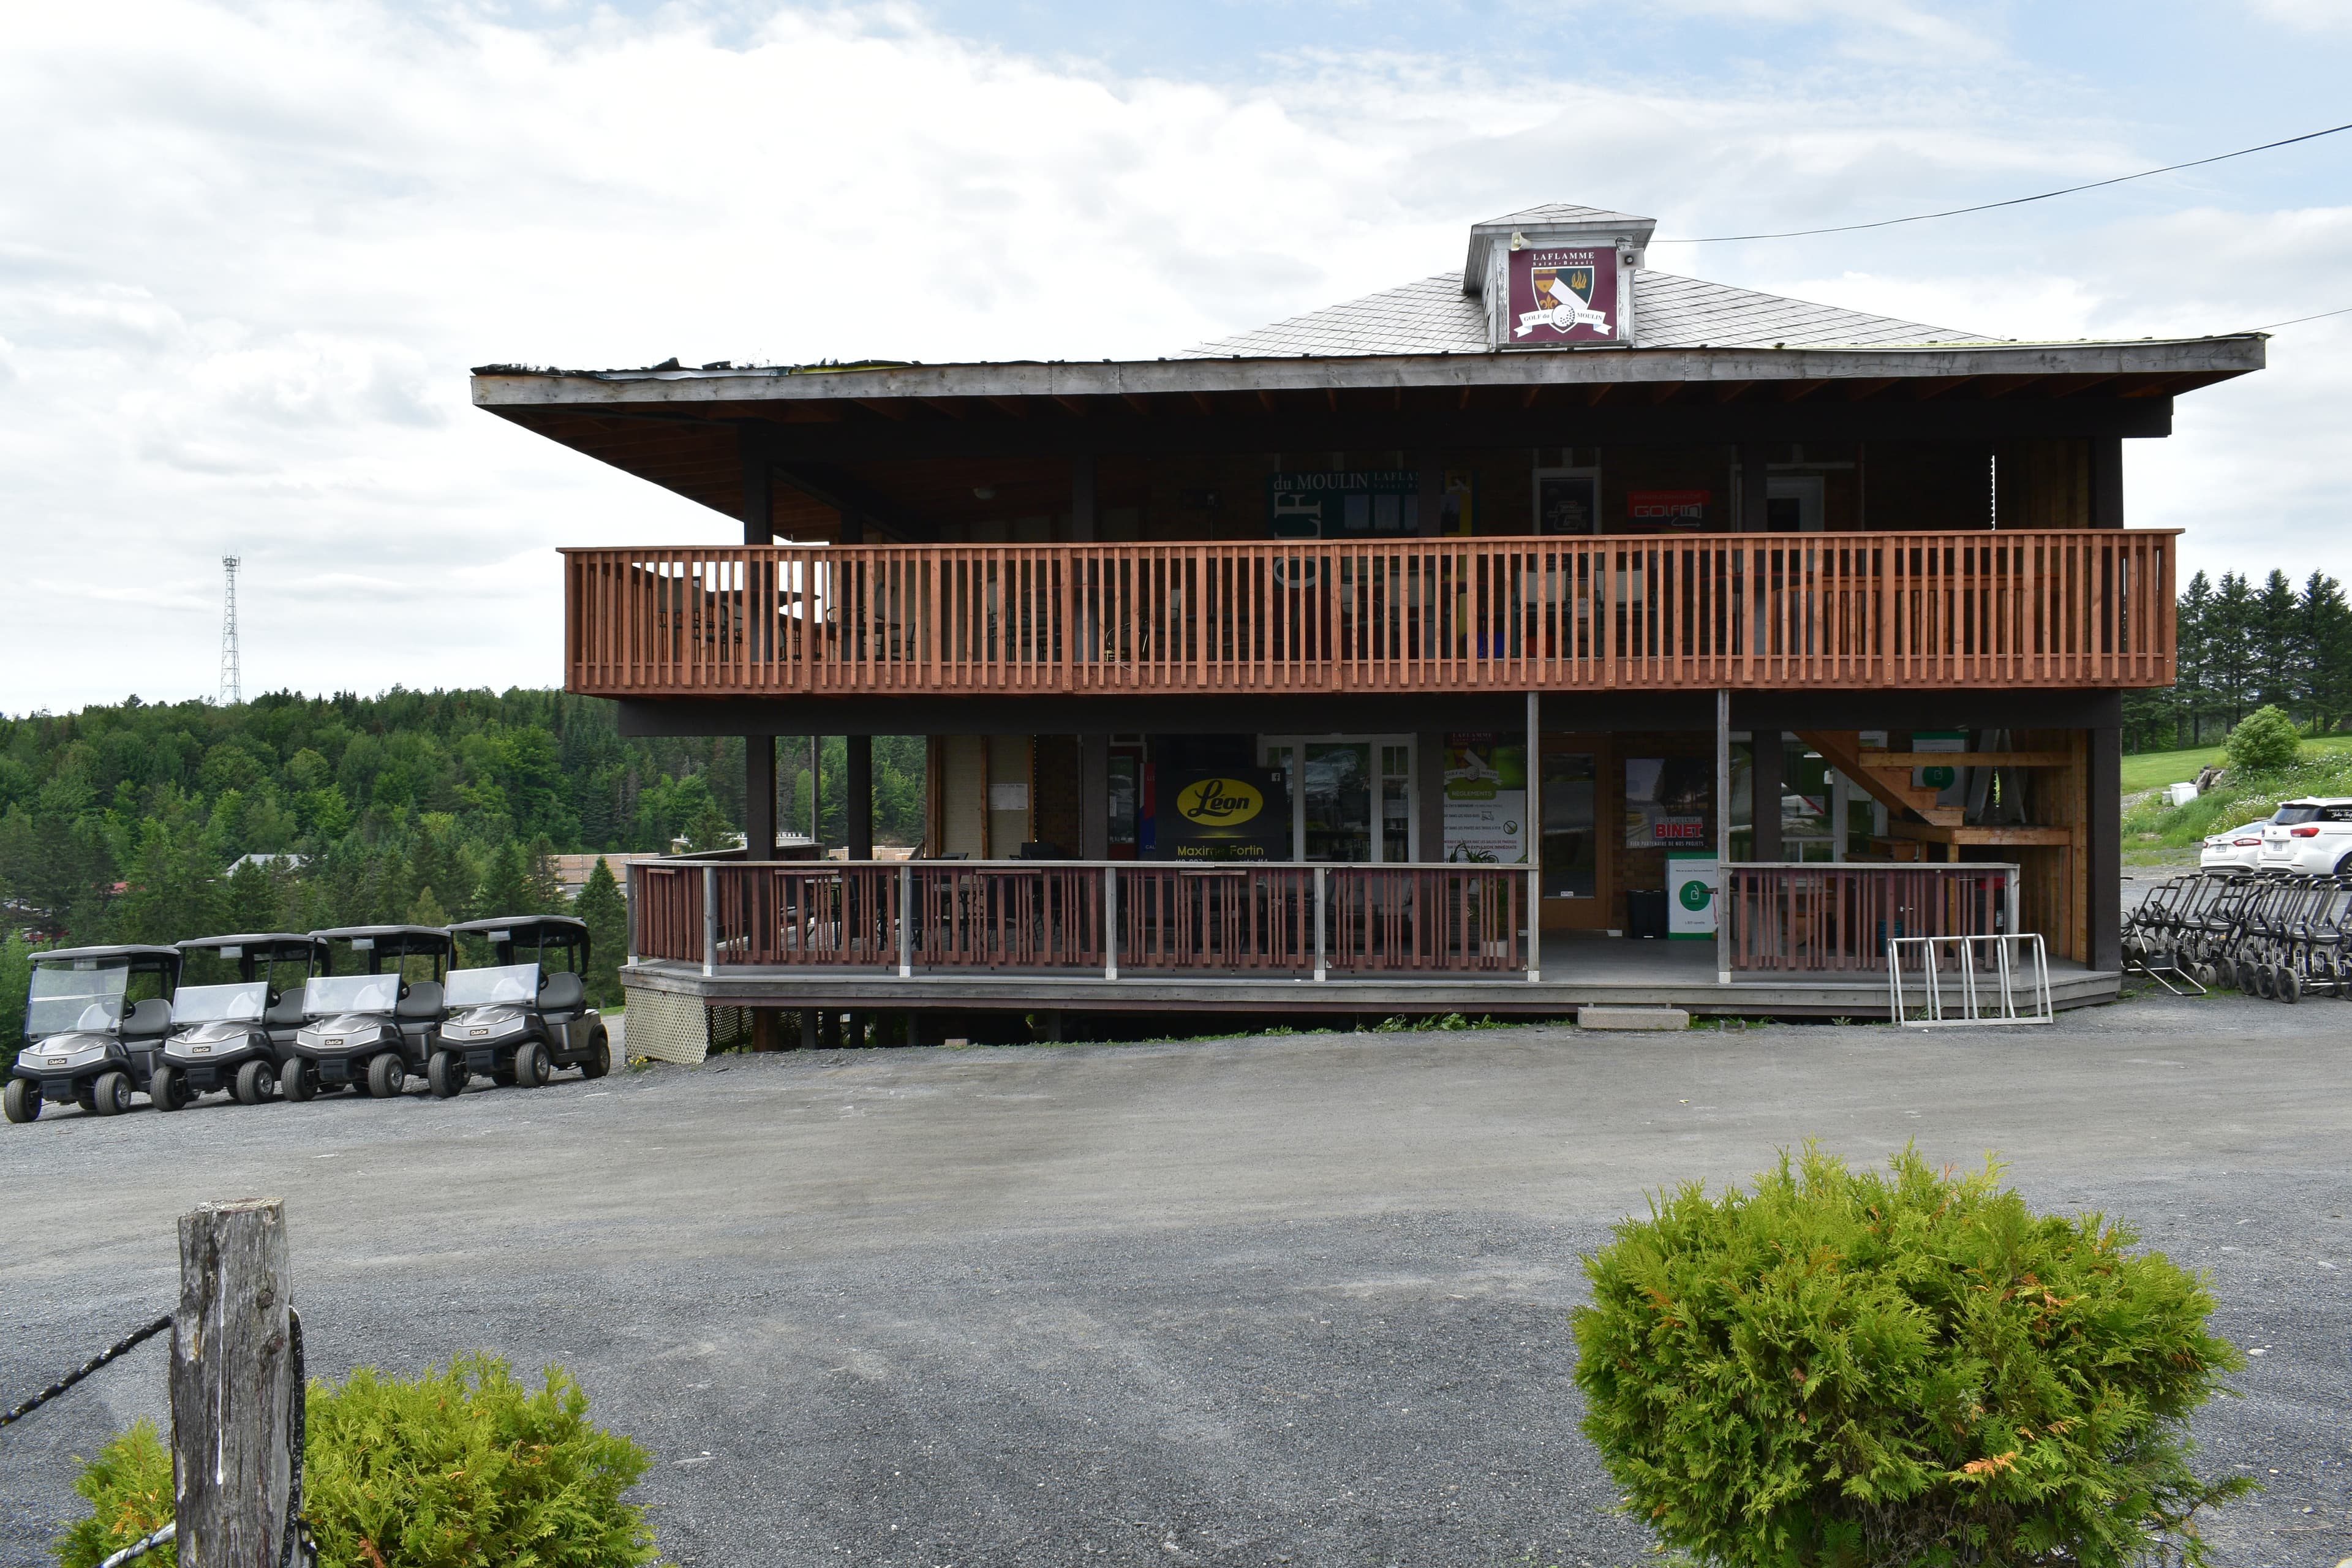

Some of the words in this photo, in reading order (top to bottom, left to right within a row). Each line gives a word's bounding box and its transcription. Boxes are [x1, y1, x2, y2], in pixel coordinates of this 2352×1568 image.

[1533, 252, 1594, 260] LAFLAMME
[1274, 475, 1292, 491] du
[1297, 473, 1368, 490] MOULIN
[1187, 779, 1250, 818] Léon
[1656, 824, 1703, 837] BINET
[1229, 844, 1264, 856] Fortin
